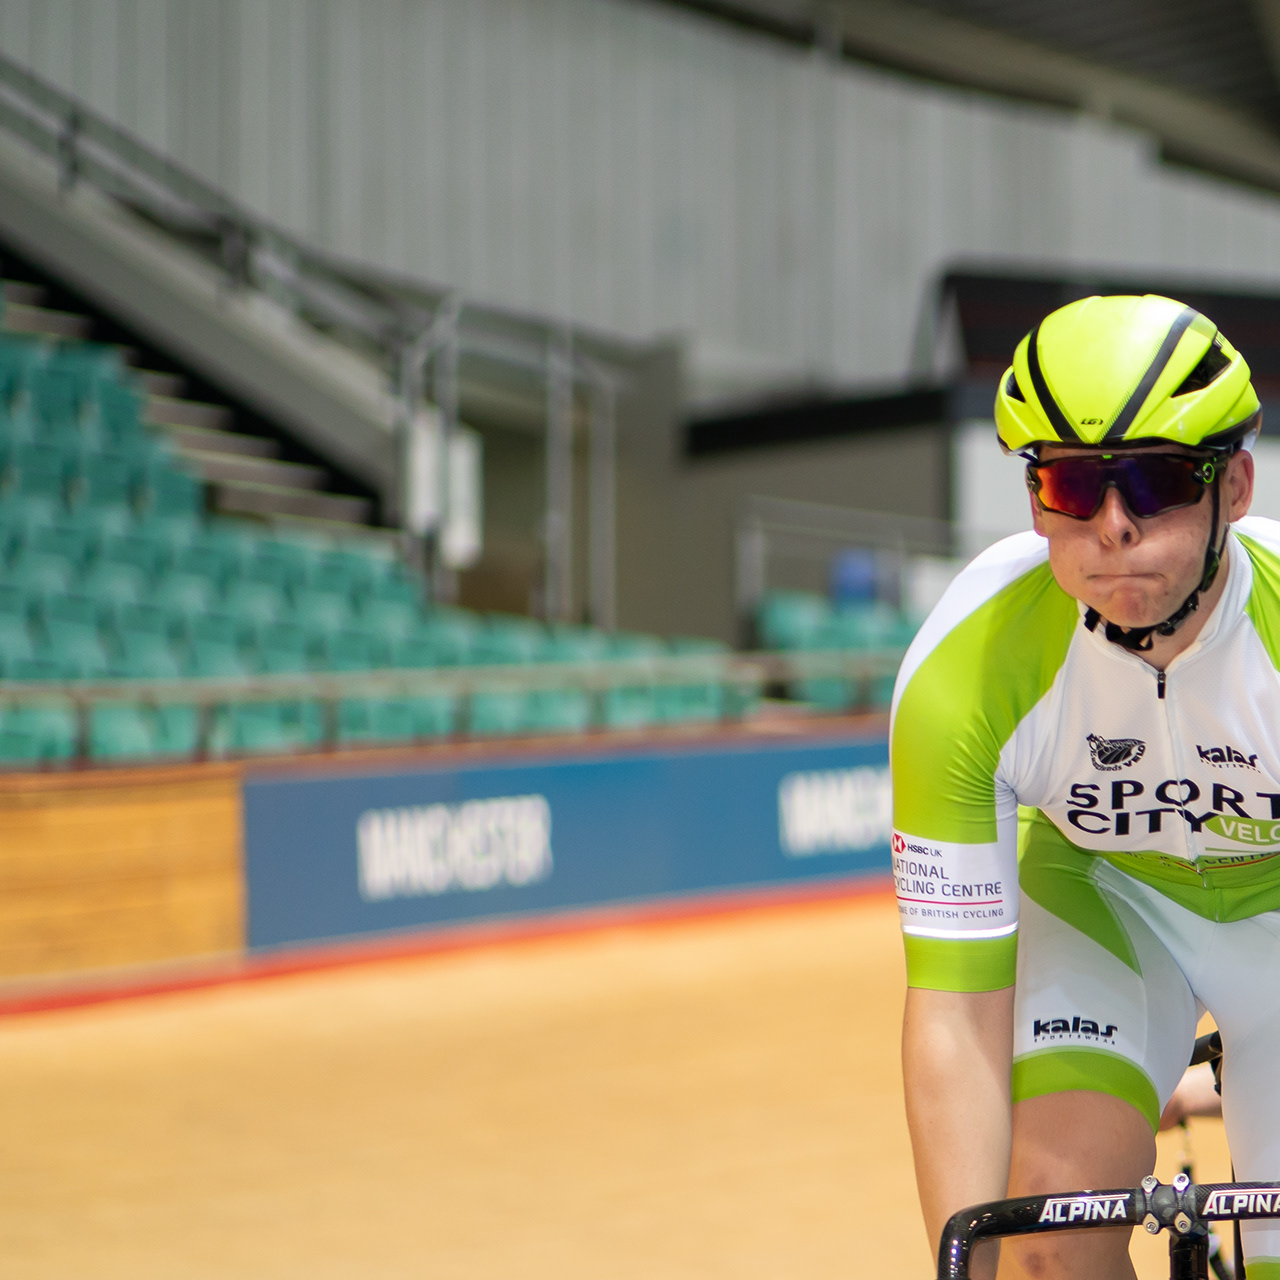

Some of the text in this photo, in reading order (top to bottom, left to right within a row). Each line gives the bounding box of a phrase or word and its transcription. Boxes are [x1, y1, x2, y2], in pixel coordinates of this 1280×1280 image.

[1067, 807, 1220, 836] CITY
[907, 843, 929, 856] HSBC
[941, 881, 1003, 897] CENTRE
[921, 908, 959, 919] BRITISH
[963, 908, 1004, 919] CYCLING
[1033, 1016, 1118, 1038] kalas
[1038, 1193, 1131, 1223] ALPINA
